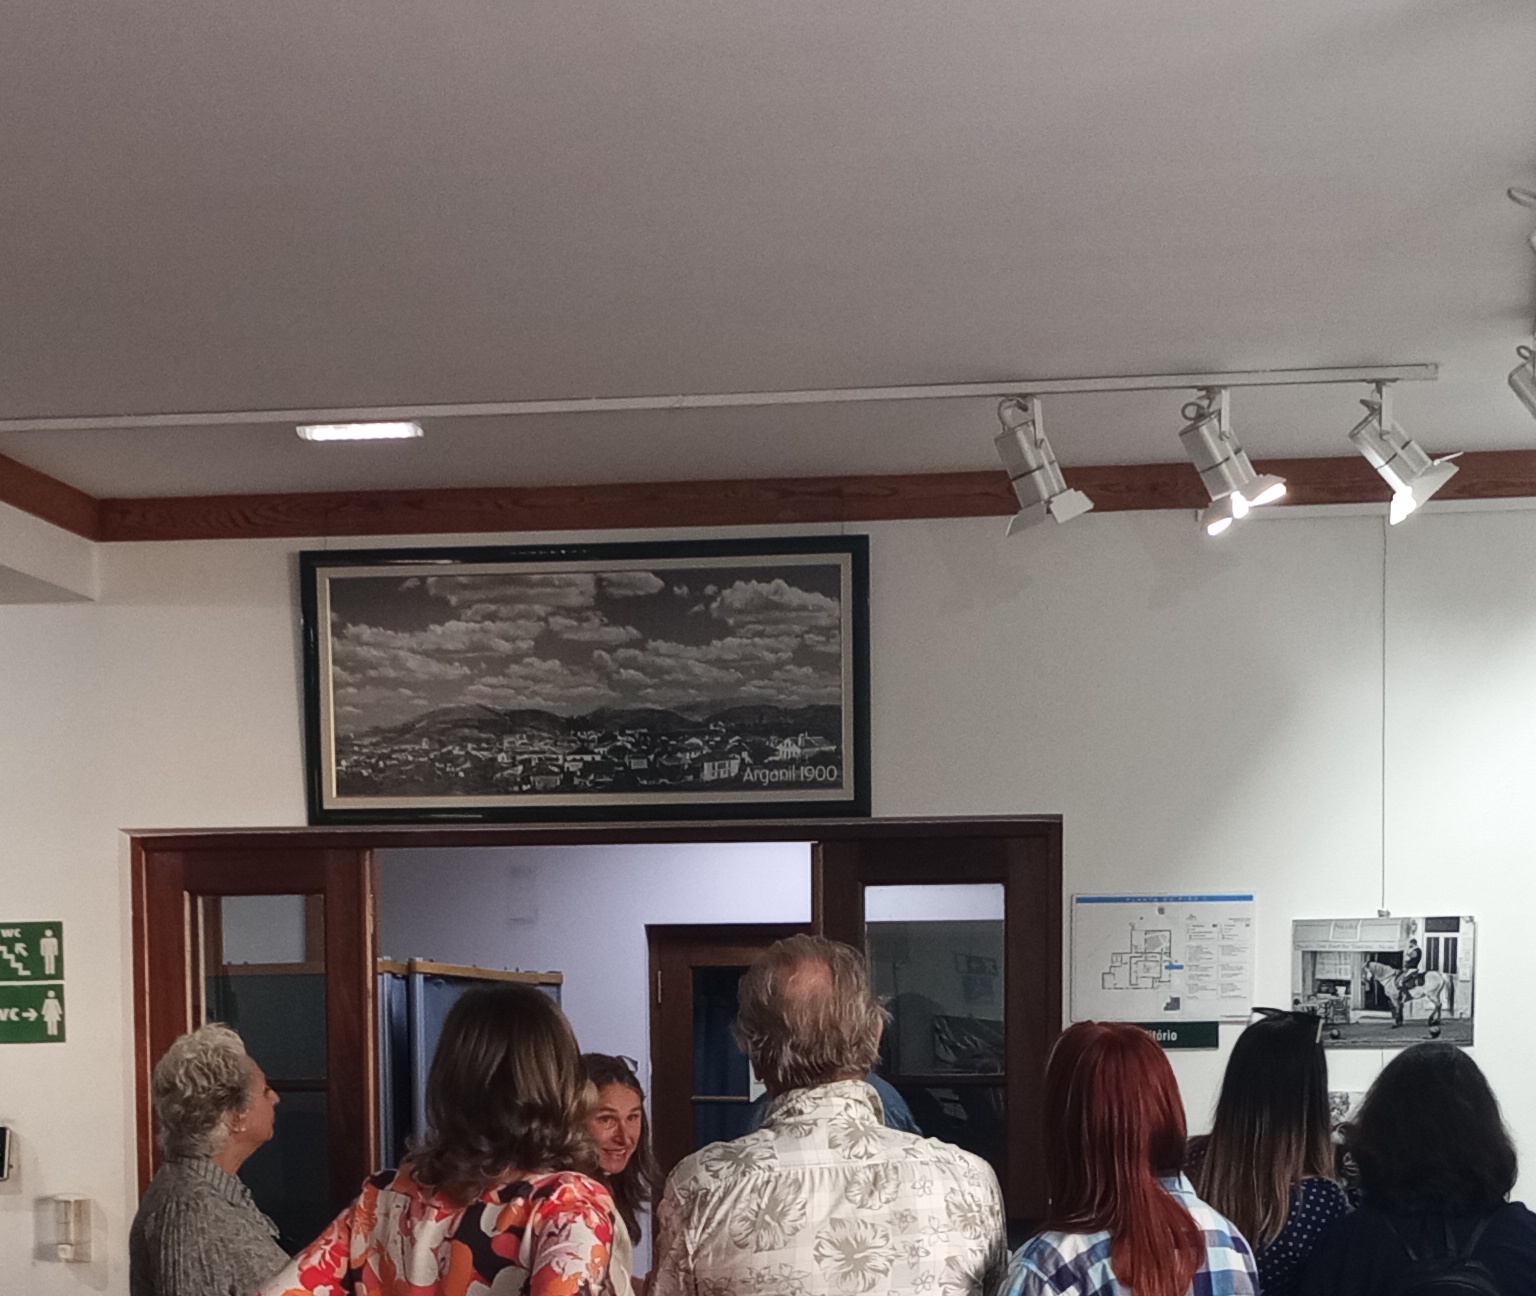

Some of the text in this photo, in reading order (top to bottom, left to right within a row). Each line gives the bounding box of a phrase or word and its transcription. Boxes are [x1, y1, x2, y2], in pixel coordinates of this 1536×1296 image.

[743, 765, 838, 786] Arganil 1900
[0, 928, 22, 938] WC
